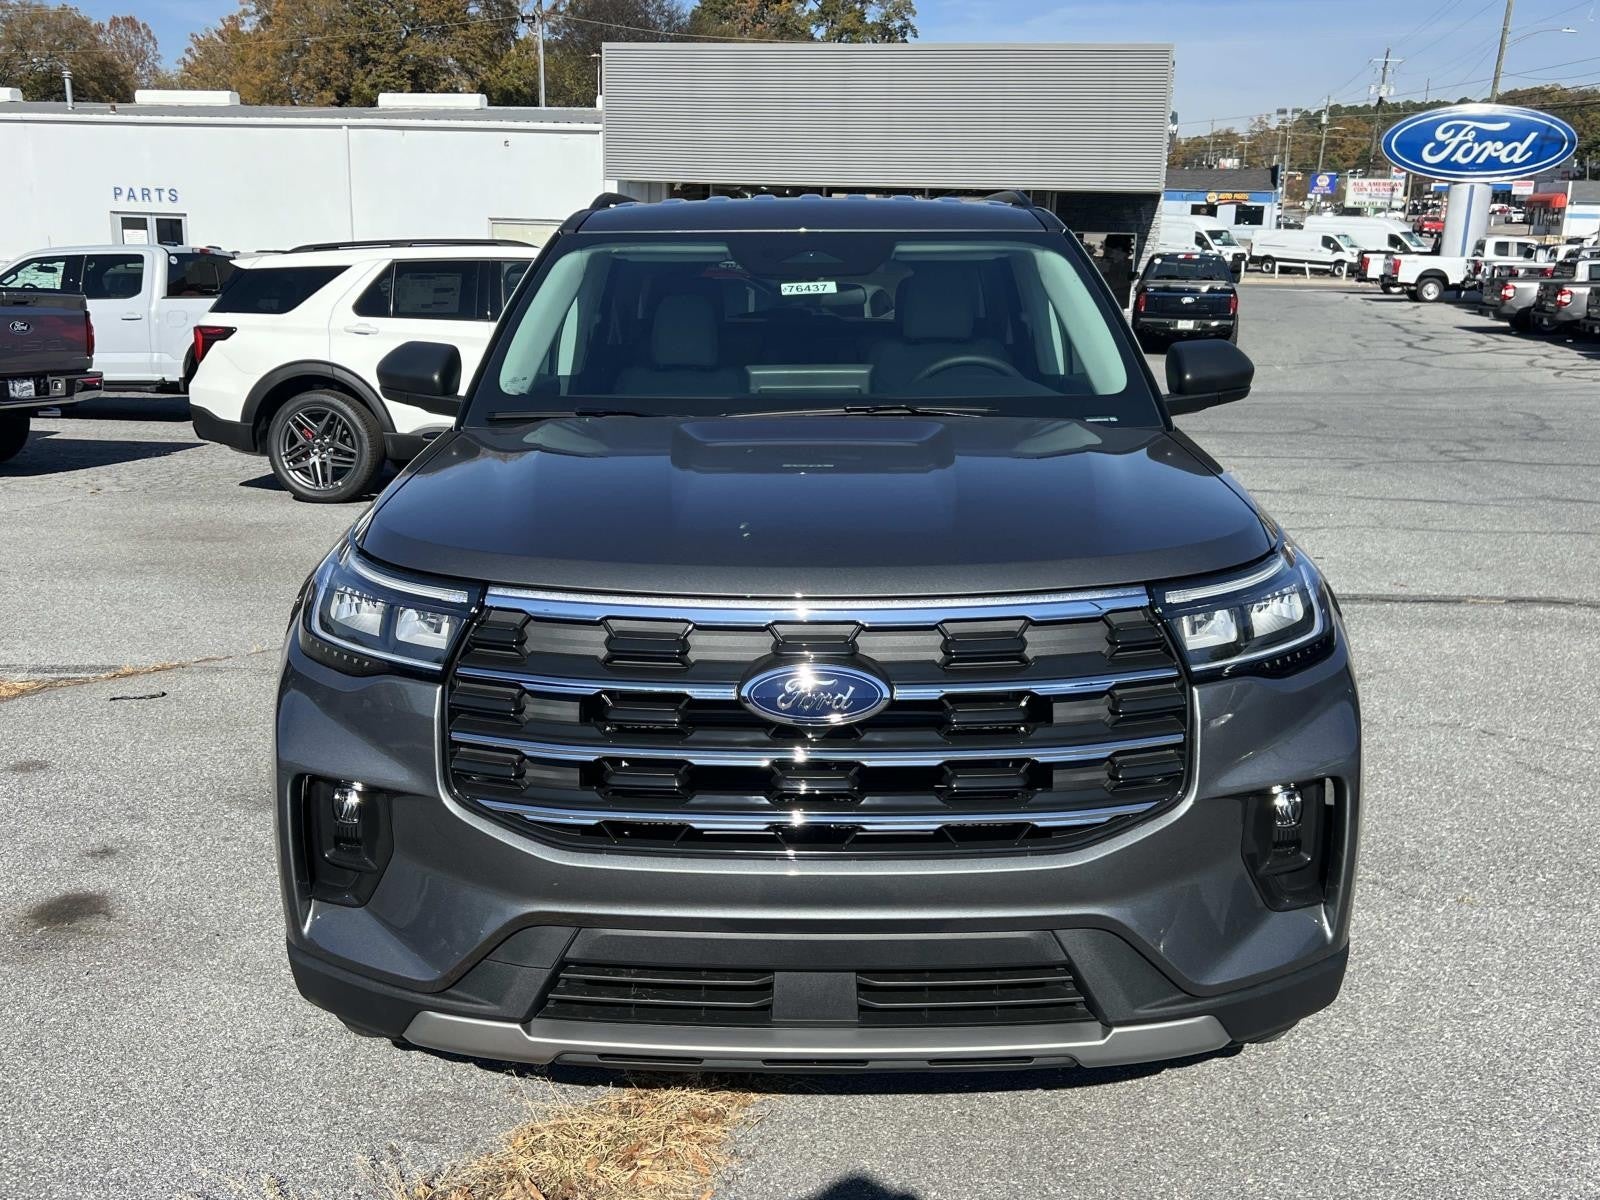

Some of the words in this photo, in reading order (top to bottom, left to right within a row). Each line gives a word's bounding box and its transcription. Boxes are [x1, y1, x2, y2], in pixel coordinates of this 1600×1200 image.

[1422, 120, 1539, 164] Ford
[113, 187, 179, 202] PARTS
[787, 284, 827, 293] 76437
[777, 678, 855, 711] Ford
